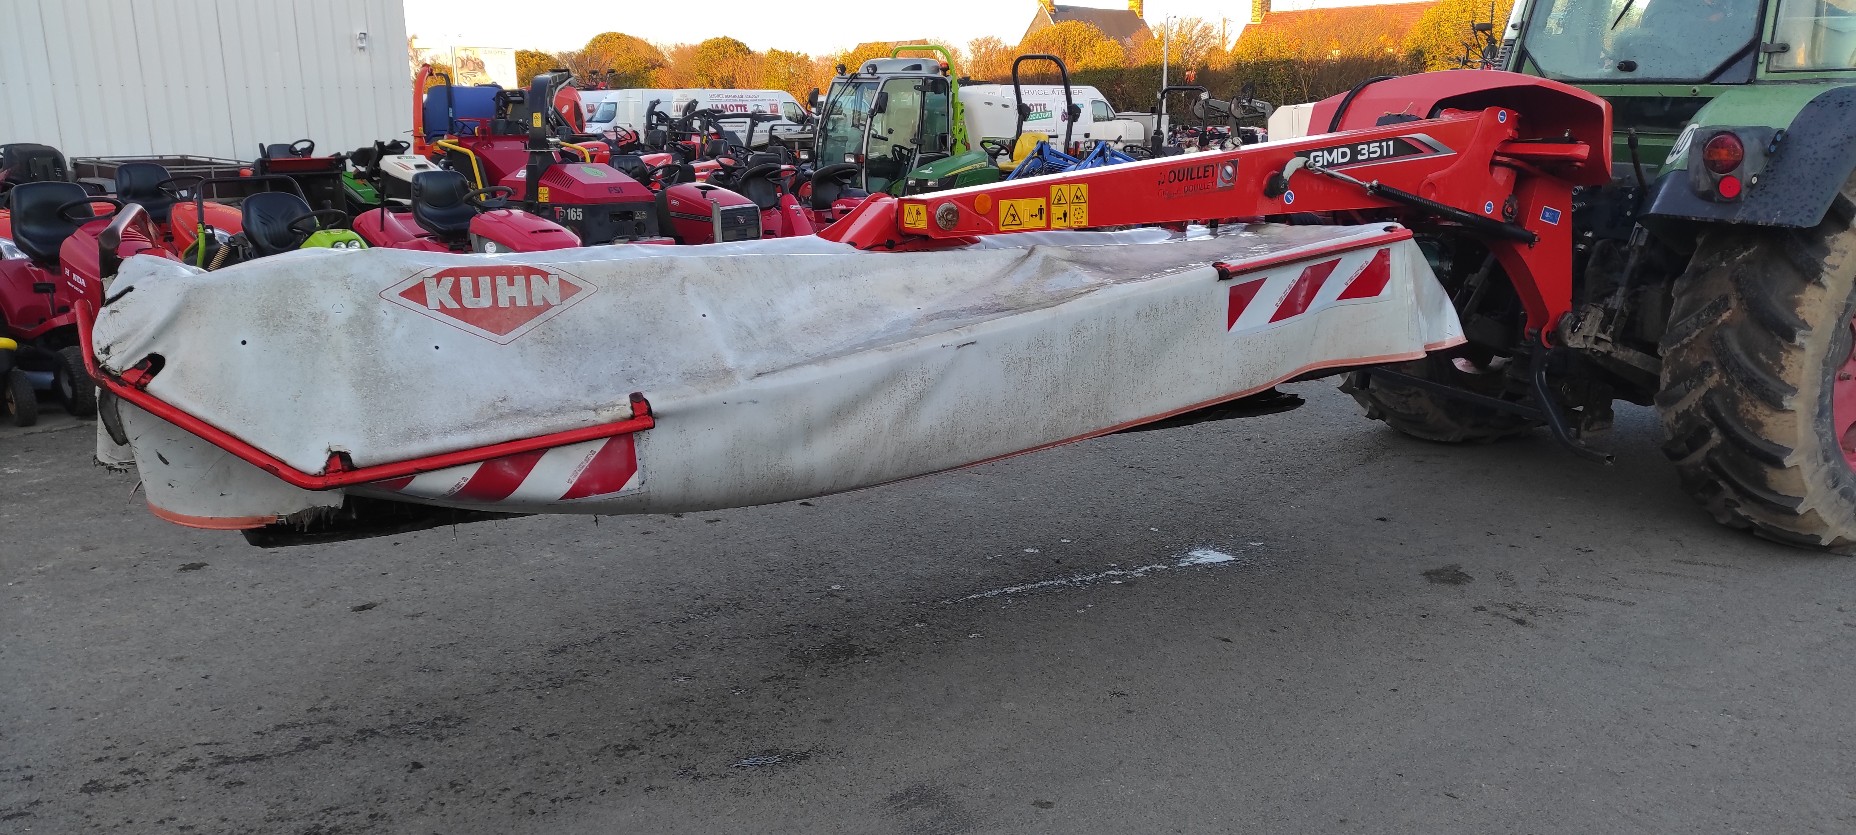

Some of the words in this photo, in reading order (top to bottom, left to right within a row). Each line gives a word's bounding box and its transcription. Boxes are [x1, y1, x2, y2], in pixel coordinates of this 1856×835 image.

[1310, 147, 1350, 167] GMD
[1357, 140, 1394, 160] 3511
[566, 207, 583, 221] 165
[64, 266, 87, 288] HNDA
[423, 273, 562, 311] KUHN
